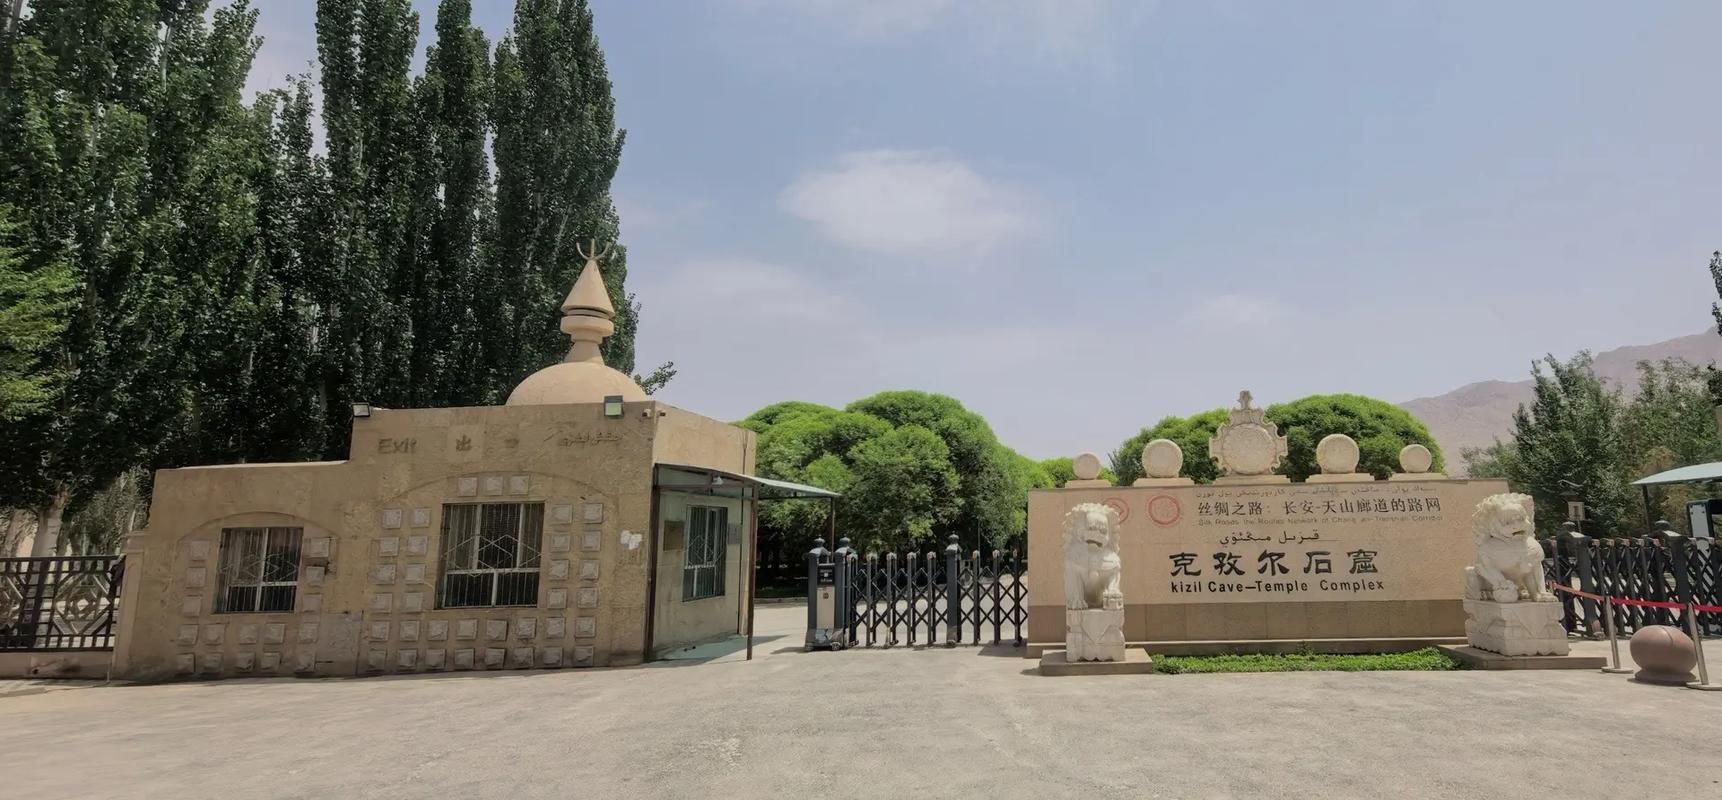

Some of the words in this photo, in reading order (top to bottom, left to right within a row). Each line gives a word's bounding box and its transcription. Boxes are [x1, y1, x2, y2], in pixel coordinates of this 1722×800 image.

[1168, 549, 1379, 577] 克孜尔石窟
[1319, 579, 1385, 593] Complex
